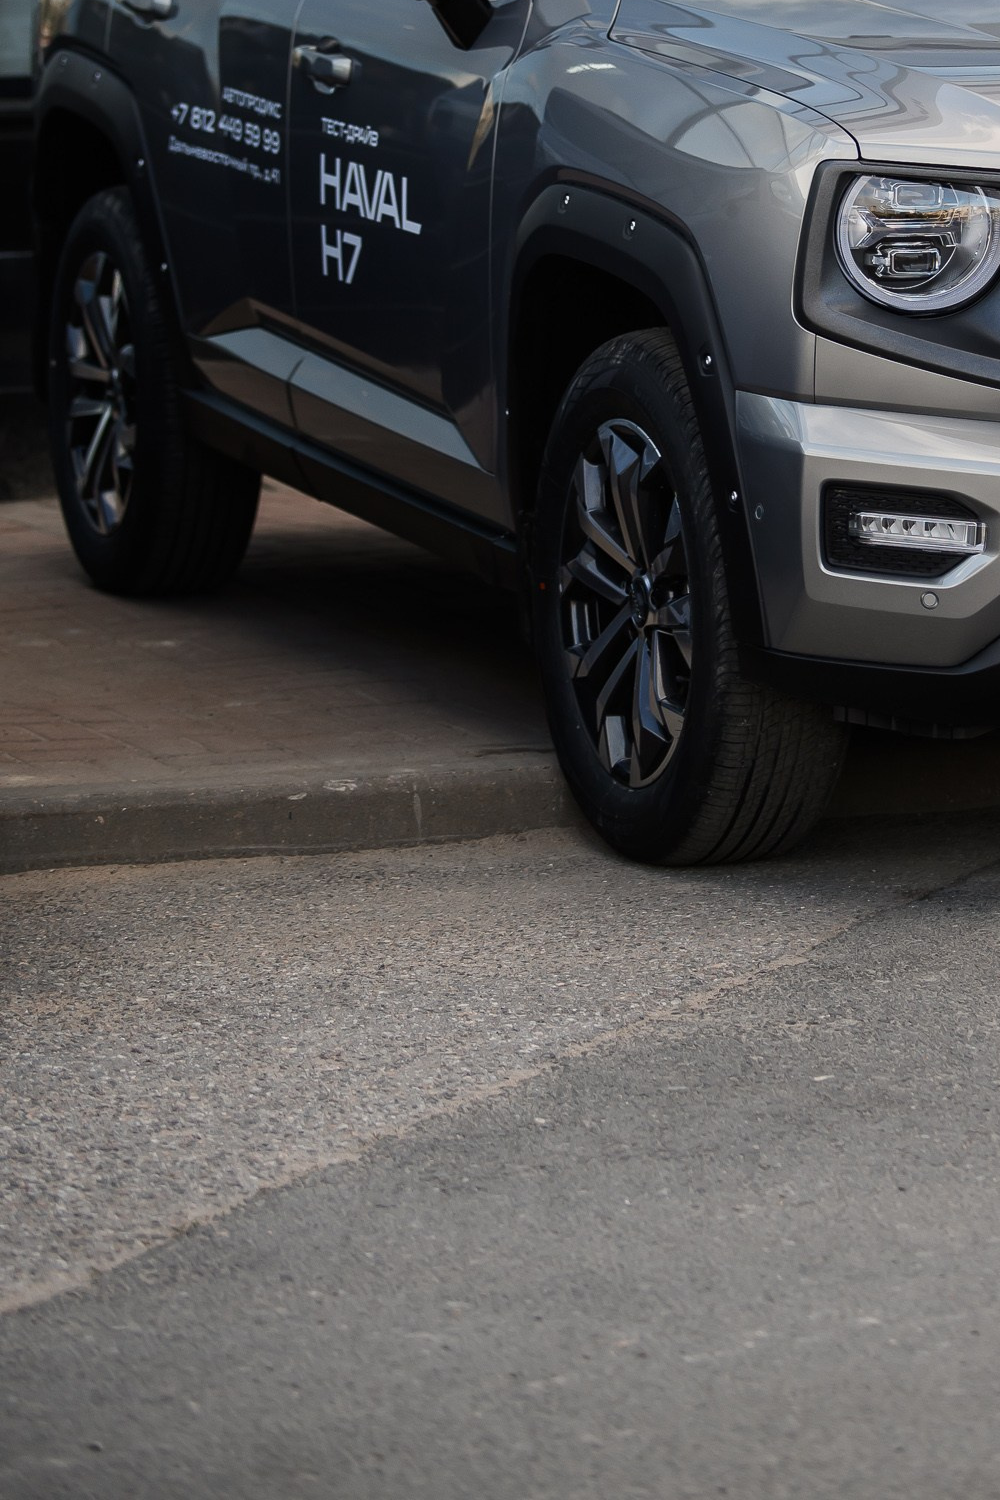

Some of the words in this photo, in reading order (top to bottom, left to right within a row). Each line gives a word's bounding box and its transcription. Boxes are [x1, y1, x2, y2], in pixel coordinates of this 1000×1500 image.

[171, 102, 189, 125] +7
[190, 106, 216, 134] 812
[218, 114, 243, 142] 449
[244, 122, 260, 148] 59
[262, 128, 280, 155] 99
[321, 117, 379, 147] ТЕСТ-ДРАЙВ
[319, 152, 422, 235] HAVAL
[320, 224, 363, 284] H7
